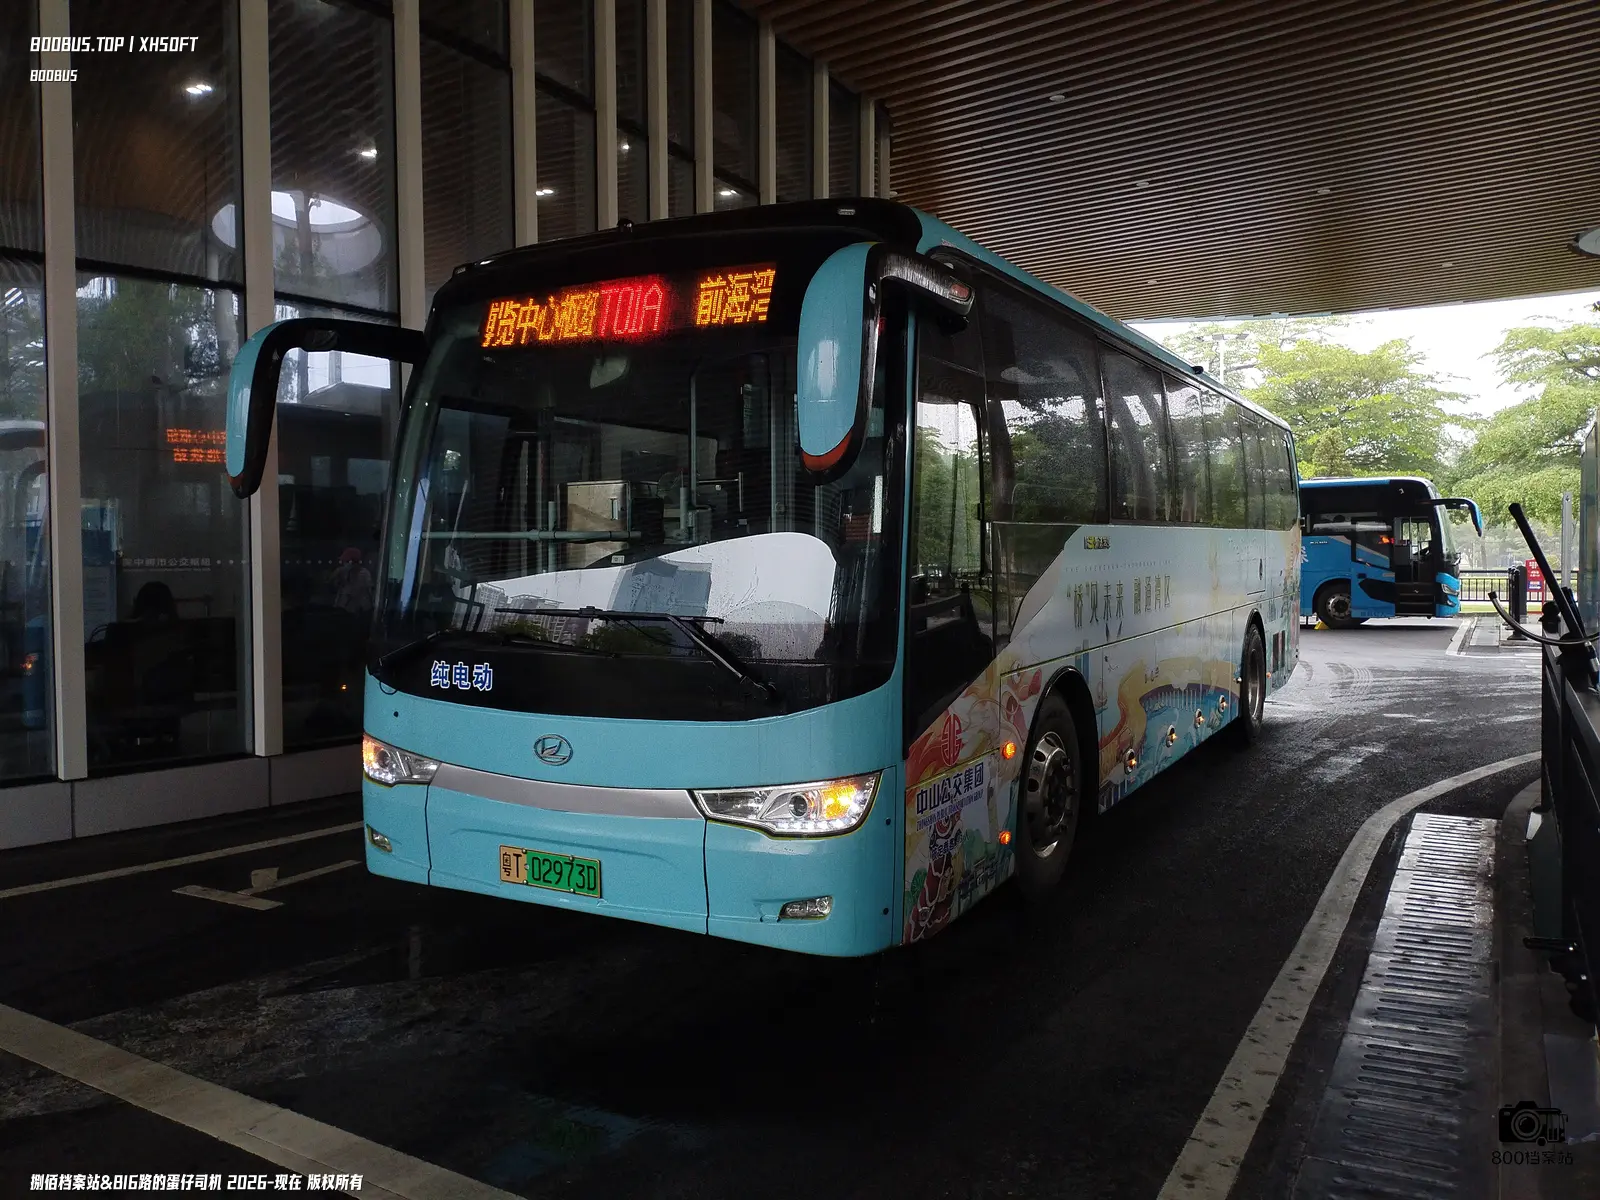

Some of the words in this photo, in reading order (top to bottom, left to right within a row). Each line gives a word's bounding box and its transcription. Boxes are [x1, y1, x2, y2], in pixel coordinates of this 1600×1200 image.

[600, 284, 663, 336] 701A
[431, 660, 493, 691] 纯电动
[916, 762, 984, 815] 中山公交集团
